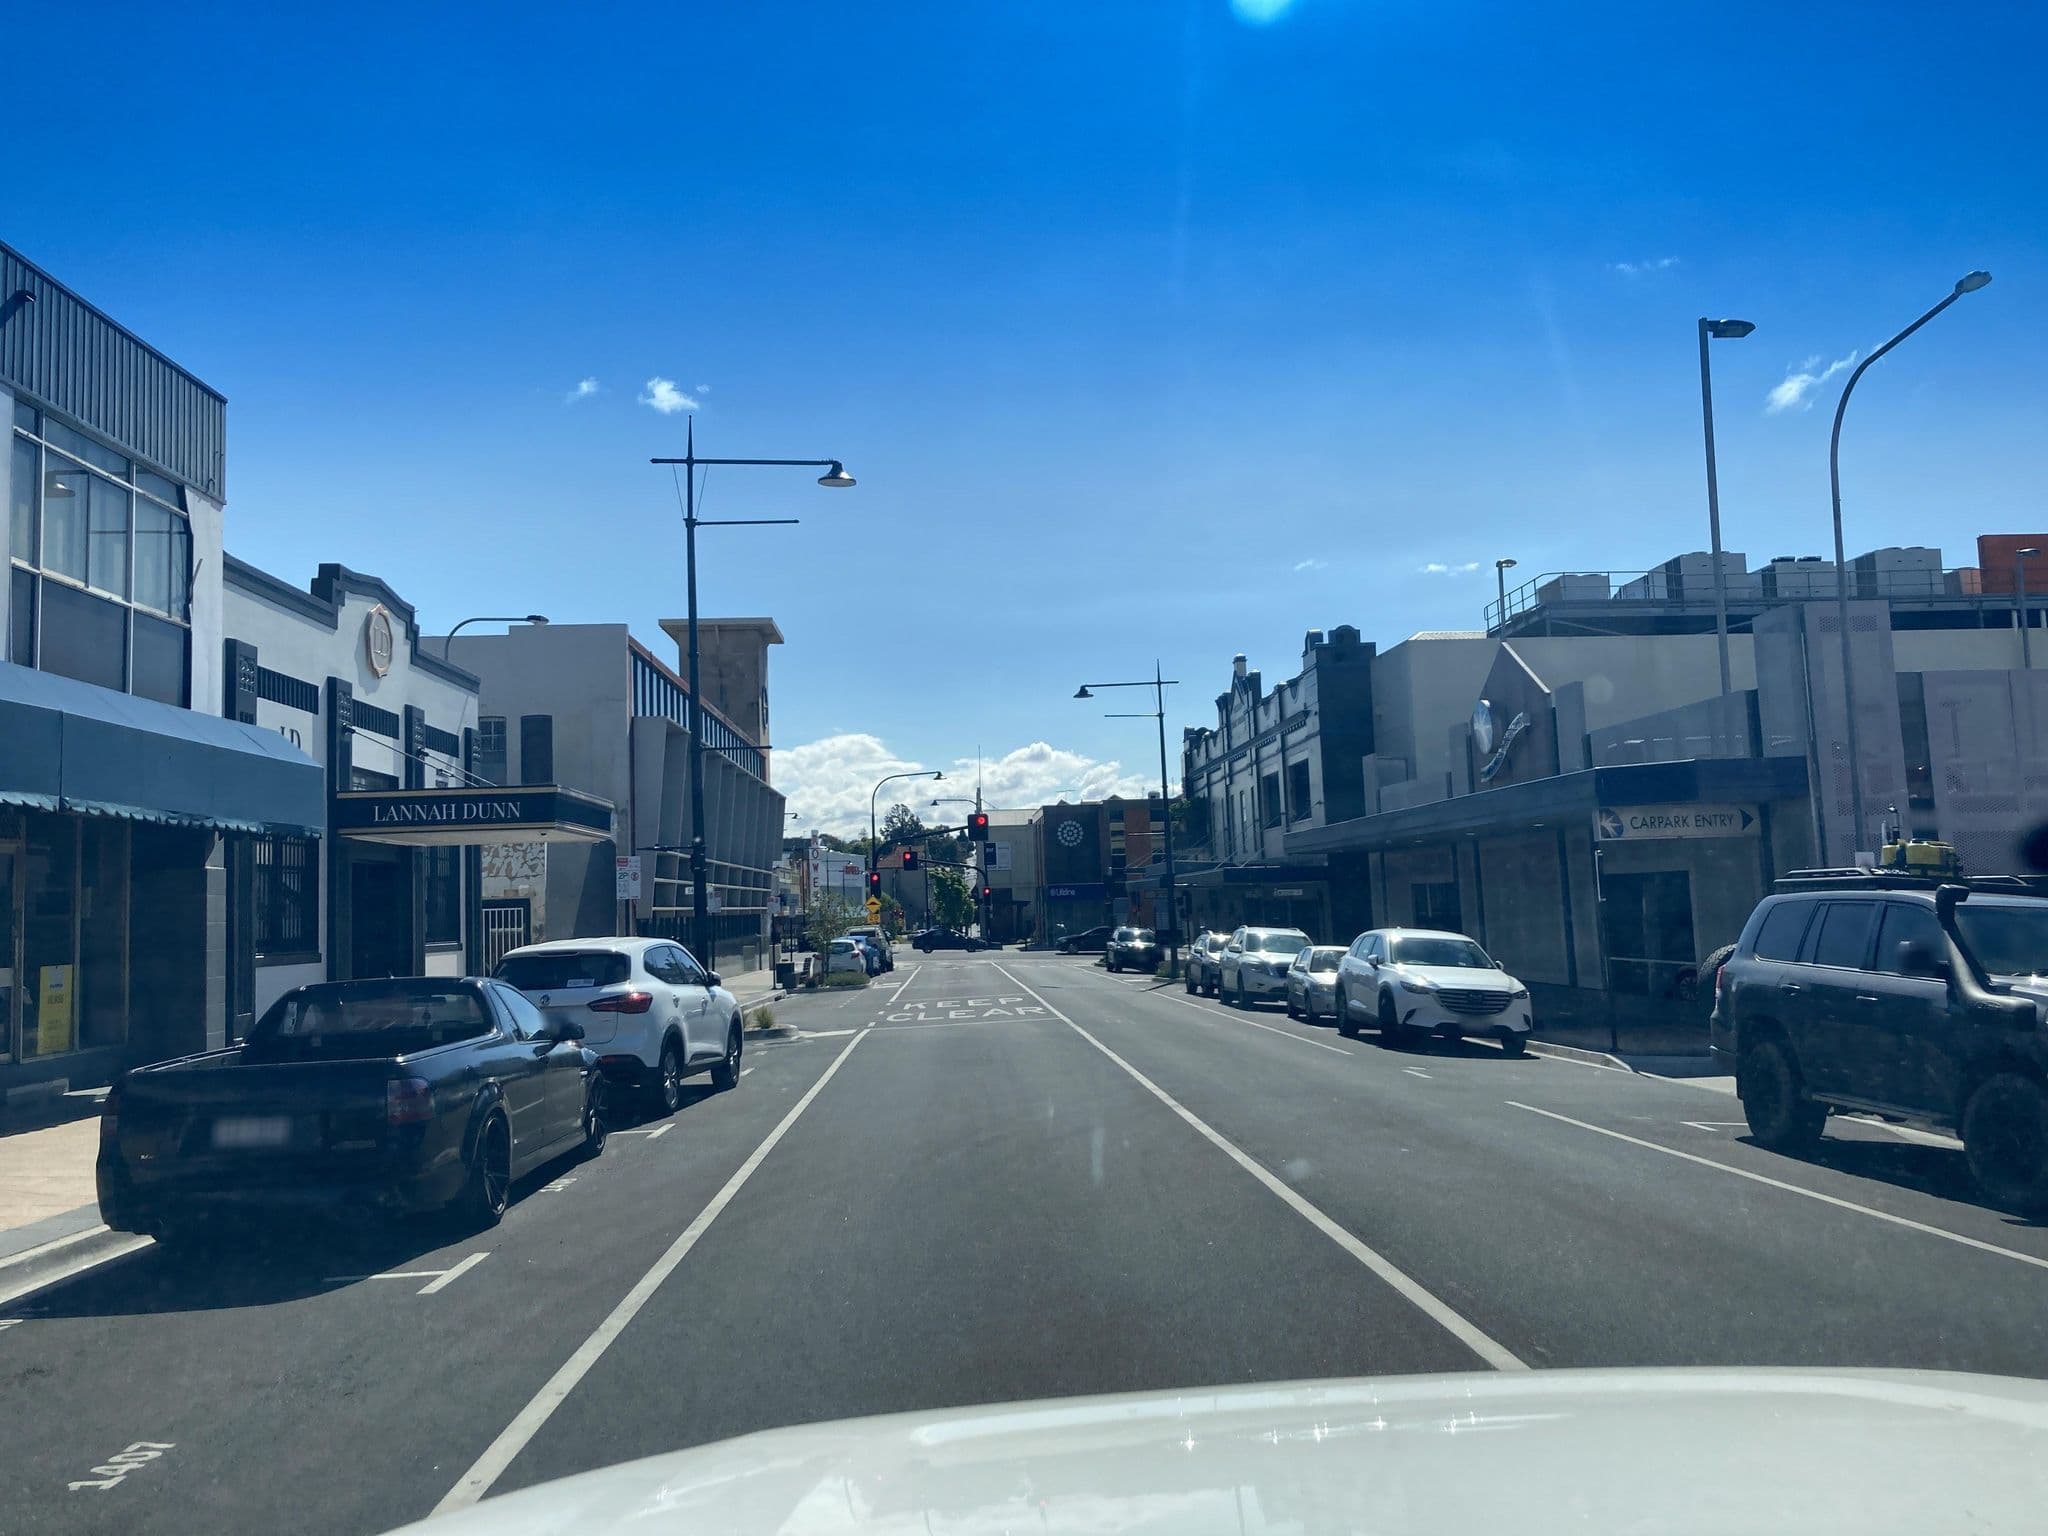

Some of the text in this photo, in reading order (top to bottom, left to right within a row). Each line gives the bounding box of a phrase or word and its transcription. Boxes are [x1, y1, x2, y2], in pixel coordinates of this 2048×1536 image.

[372, 801, 522, 824] LANNAH DUNN
[1630, 813, 1734, 831] CARPARK ENTRY
[904, 997, 1024, 1010] KEEP
[886, 1006, 1048, 1022] CLEAR
